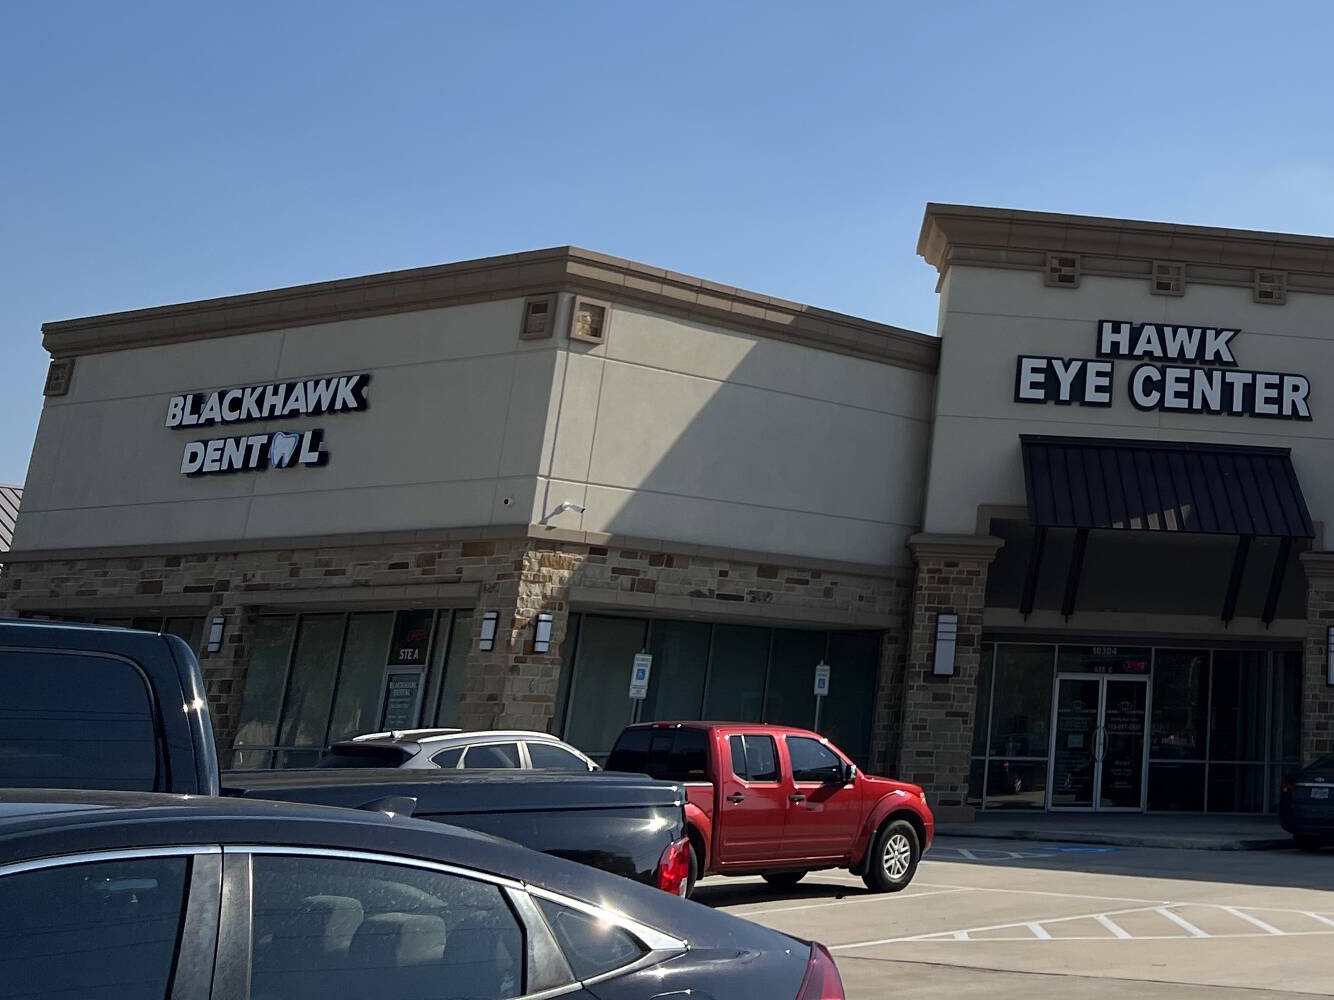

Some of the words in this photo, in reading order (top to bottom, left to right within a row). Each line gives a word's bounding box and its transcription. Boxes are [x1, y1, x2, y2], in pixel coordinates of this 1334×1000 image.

[1099, 321, 1237, 363] HAWK
[164, 374, 363, 428] BLACKHAWK
[1018, 357, 1113, 404] EYE
[1131, 363, 1311, 418] CENTER
[179, 430, 321, 475] DENTL
[399, 648, 414, 660] STE
